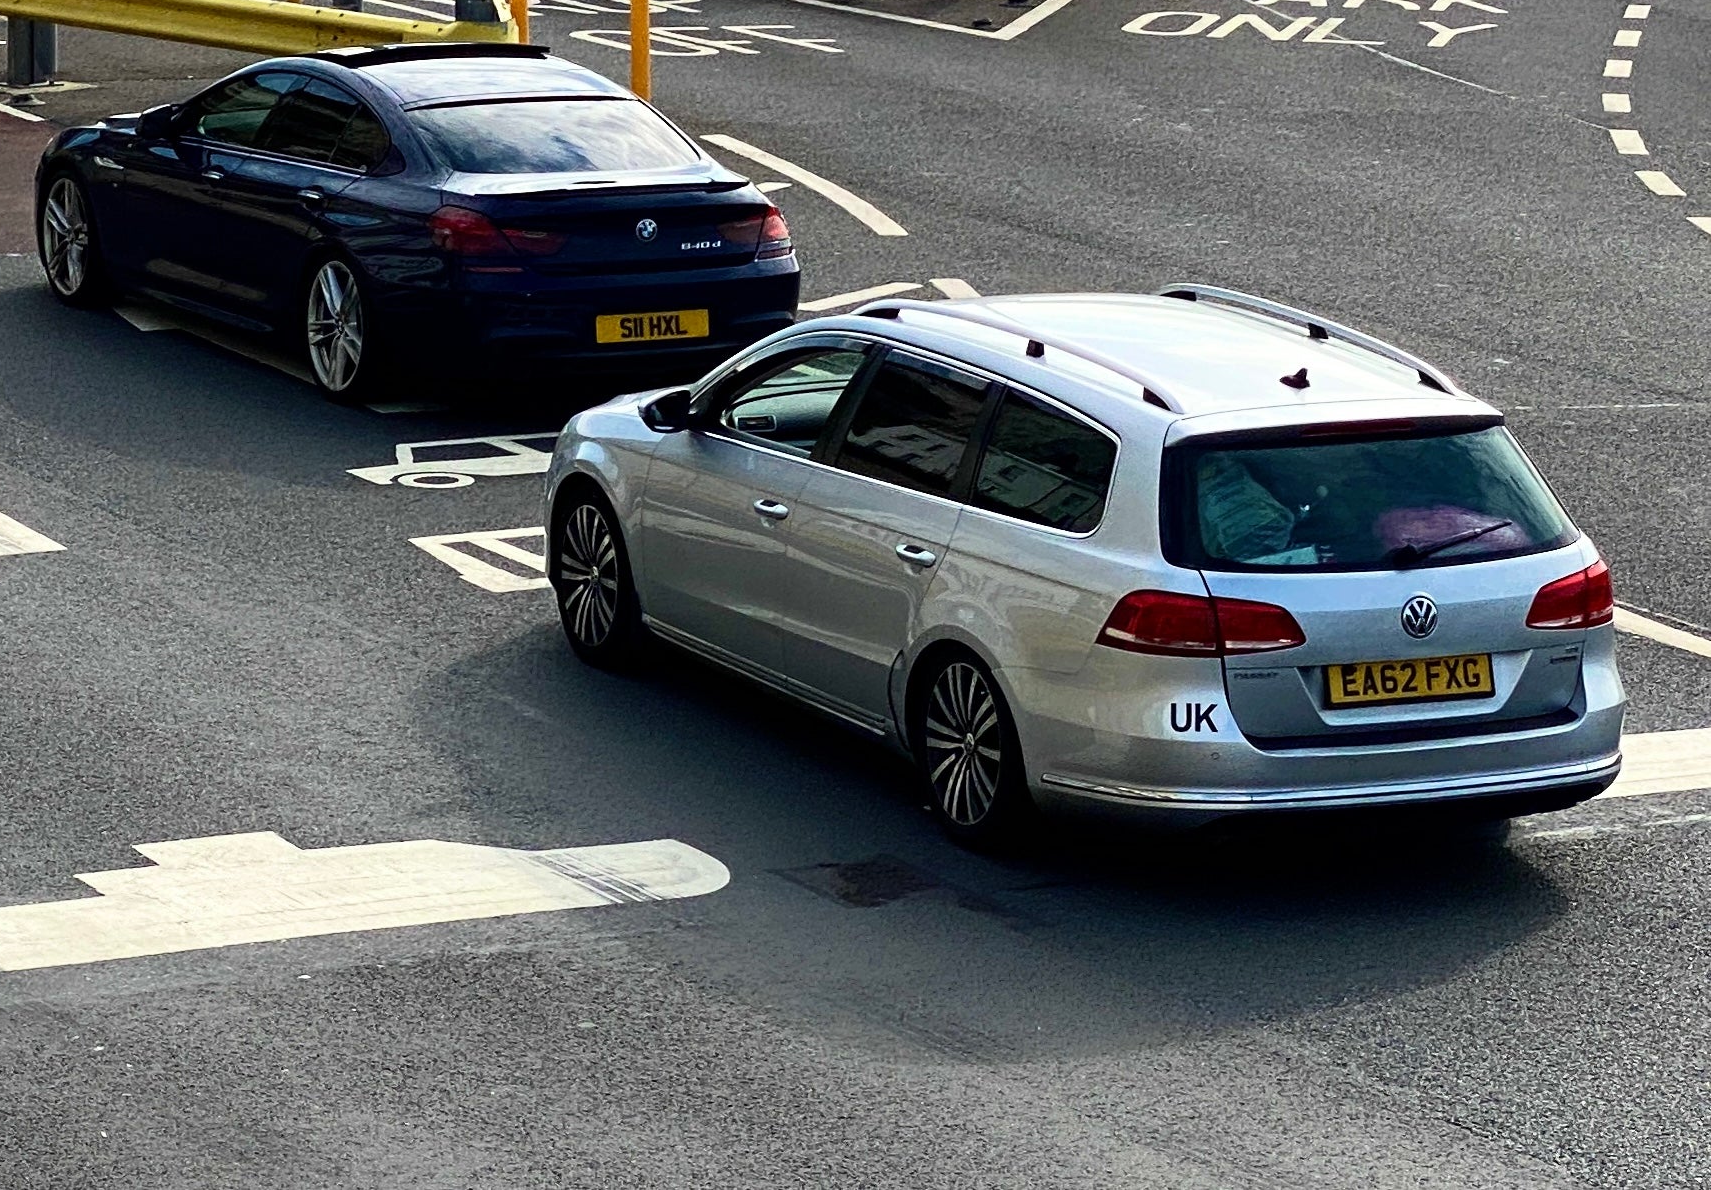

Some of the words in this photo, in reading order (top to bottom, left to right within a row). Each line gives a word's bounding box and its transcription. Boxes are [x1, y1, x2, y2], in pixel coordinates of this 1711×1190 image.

[568, 24, 846, 58] OFF
[1120, 11, 1499, 49] ONLY
[649, 314, 689, 337] HXL
[1340, 660, 1420, 697] EA62
[1425, 656, 1482, 691] FXG
[1169, 702, 1219, 735] UK
